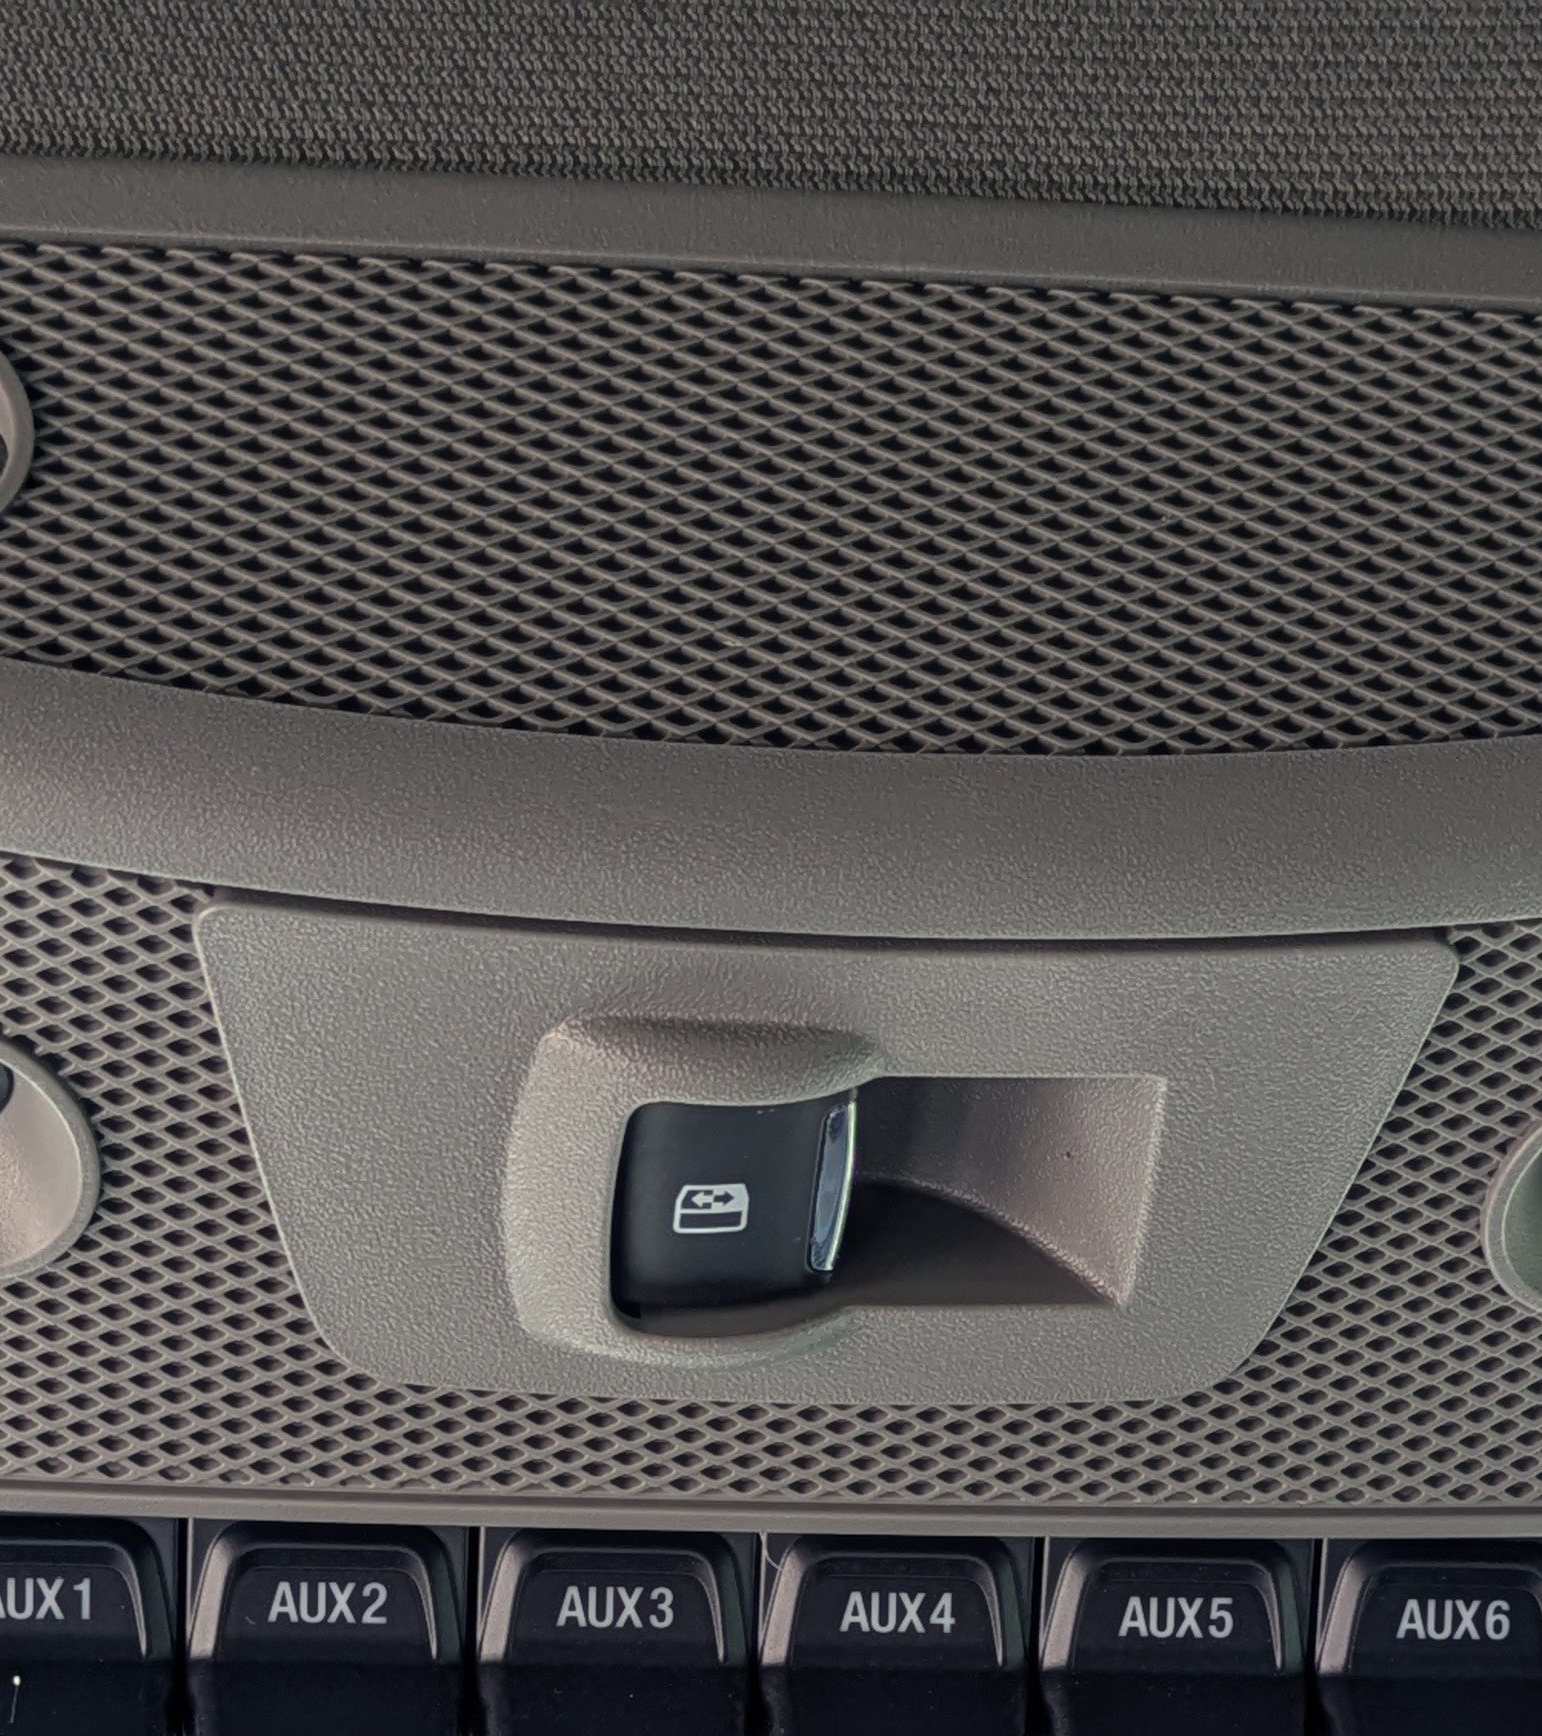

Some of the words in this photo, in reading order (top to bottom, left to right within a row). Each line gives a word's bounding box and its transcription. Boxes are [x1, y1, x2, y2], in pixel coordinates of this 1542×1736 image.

[267, 1580, 389, 1625] AUX2
[555, 1584, 675, 1630] AUX3
[839, 1590, 957, 1635] AUX4
[1117, 1595, 1235, 1640] AUX5
[1395, 1597, 1511, 1641] AUX6
